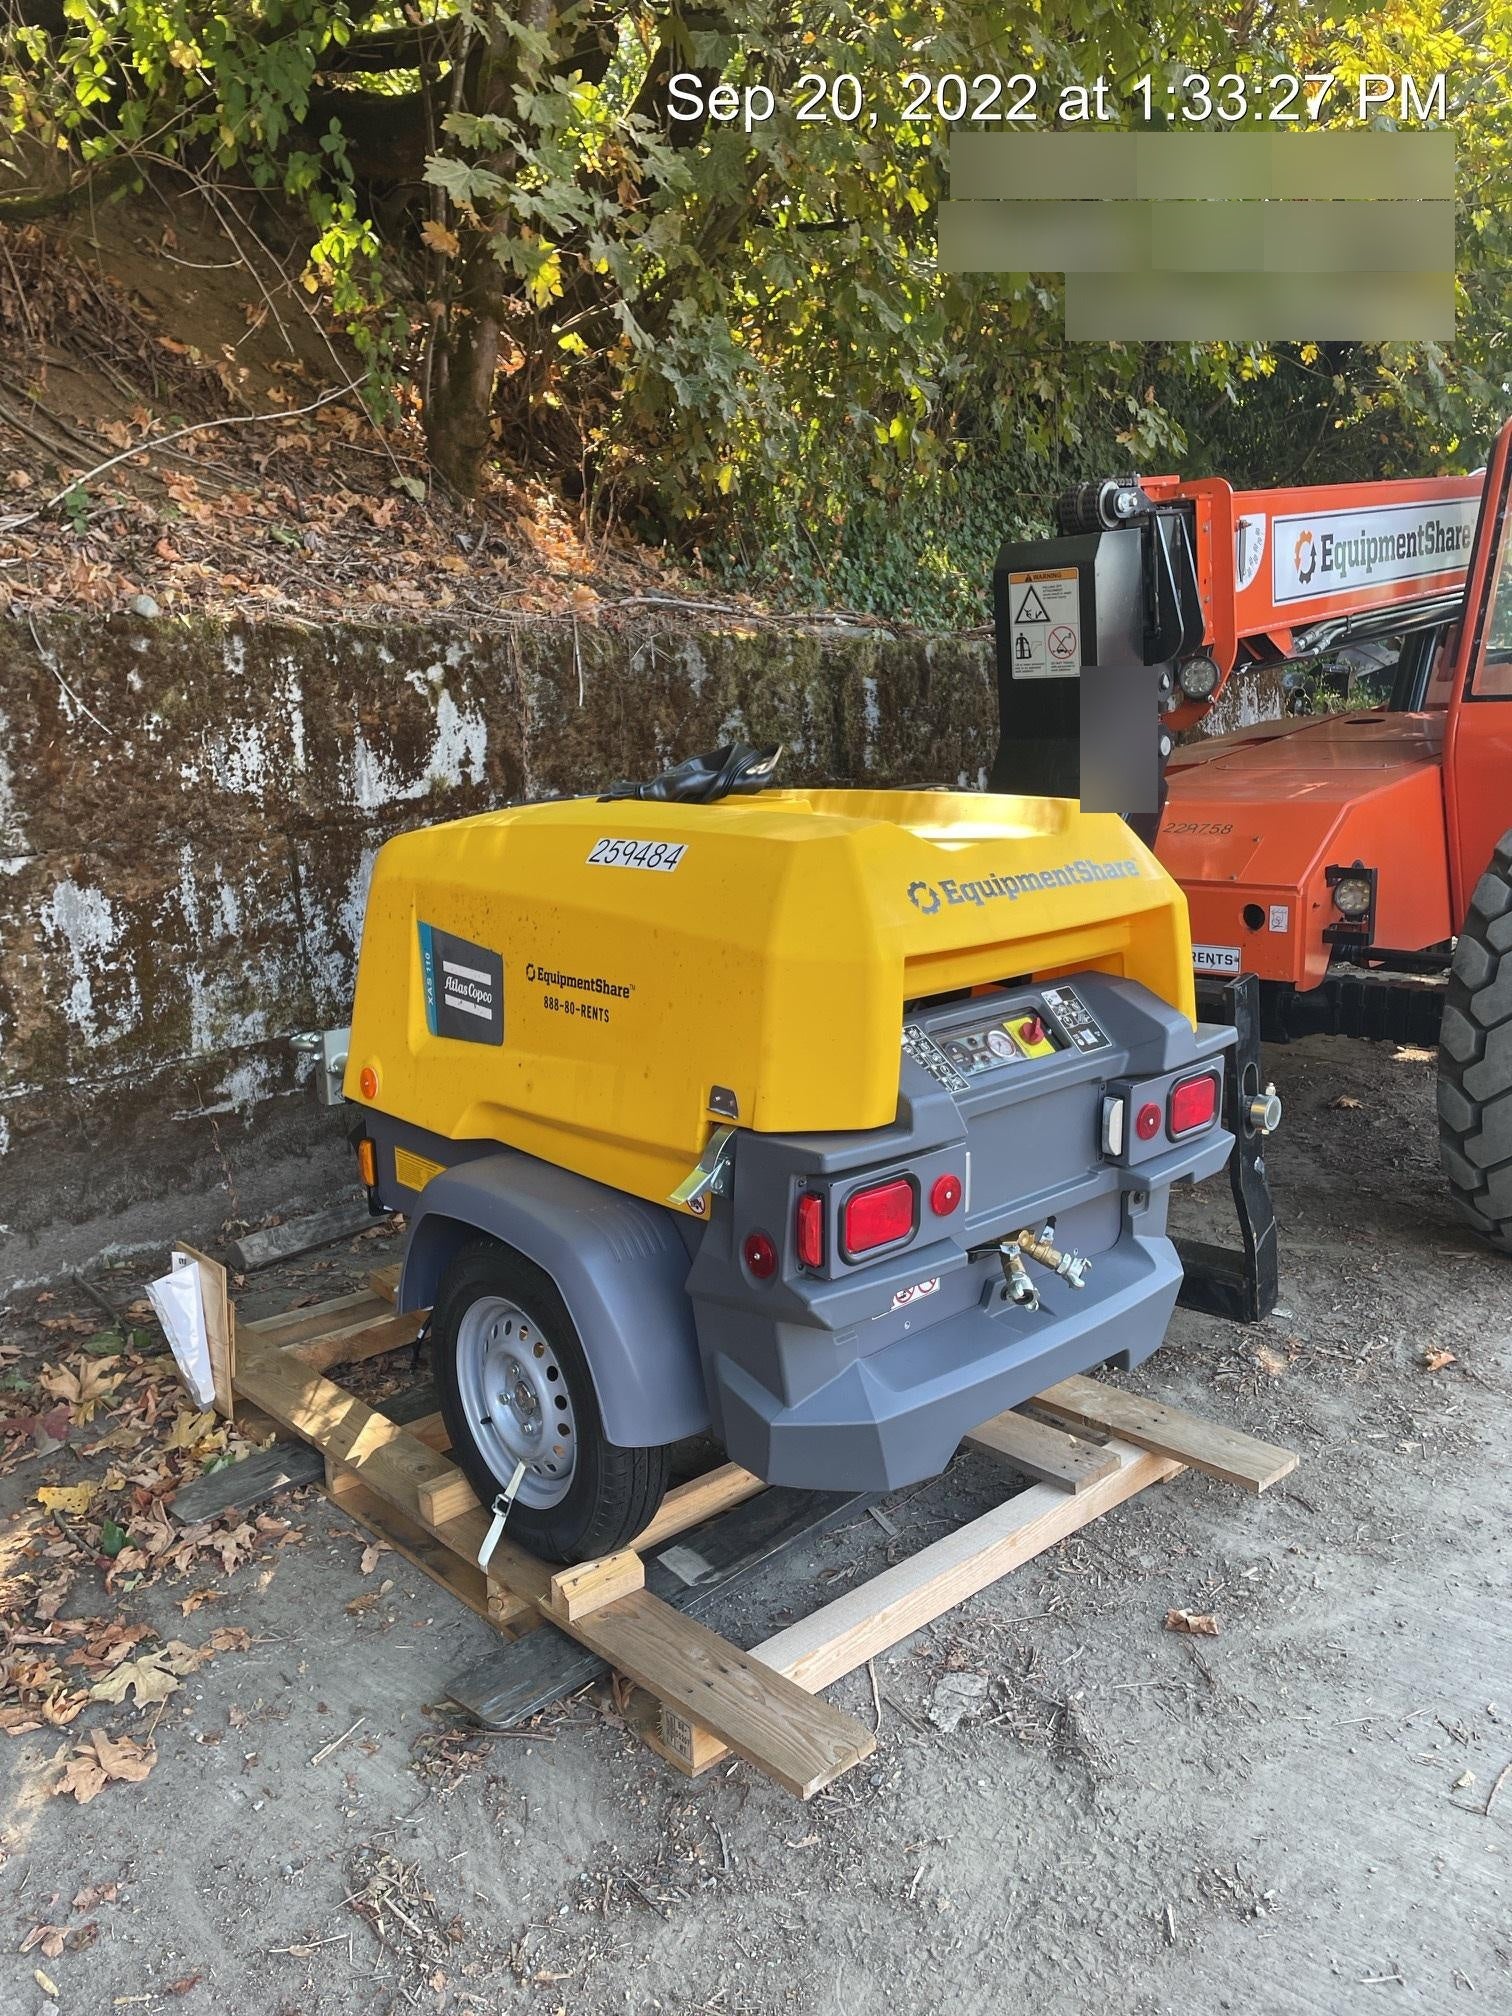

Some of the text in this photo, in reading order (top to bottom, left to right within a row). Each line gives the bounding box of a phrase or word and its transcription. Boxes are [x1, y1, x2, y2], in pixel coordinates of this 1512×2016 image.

[1321, 520, 1472, 578] EquipmentShare
[1033, 571, 1061, 580] WARNING
[588, 838, 685, 870] 259484
[938, 860, 1139, 906] EquipmentShare
[444, 976, 492, 1004] Atlas Copco
[543, 995, 610, 1023] 888-80-RENTS
